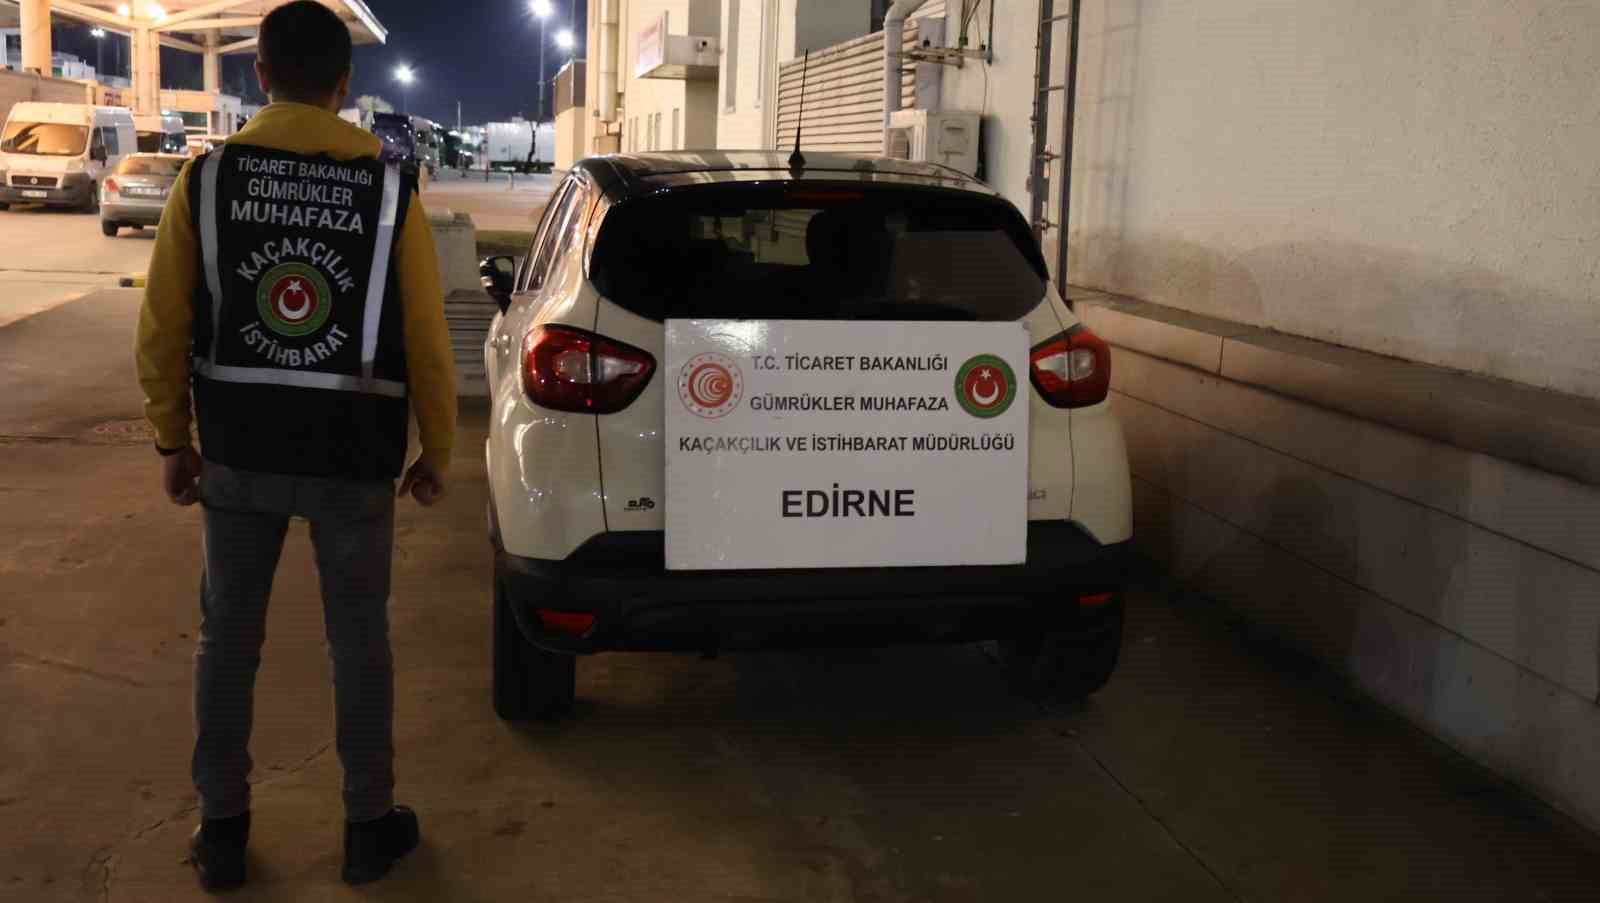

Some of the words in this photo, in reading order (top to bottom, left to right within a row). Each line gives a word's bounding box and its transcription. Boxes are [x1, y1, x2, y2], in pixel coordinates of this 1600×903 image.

[237, 155, 296, 176] TİCARET
[298, 162, 373, 187] BAKANLIĞI
[247, 175, 353, 207] GÜMRÜKLER
[231, 199, 364, 234] MUHAFAZA
[236, 237, 354, 293] KAÇAKÇILIK
[240, 321, 349, 366] İSTİHBARAT
[752, 355, 780, 371] T.C.
[785, 352, 855, 371] TİCARET
[859, 353, 948, 371] BAKANLIĞI
[750, 393, 856, 412] GÜMRÜKLER
[859, 396, 949, 411] MUHAFAZA
[679, 437, 781, 455] KAÇAKÇILIK
[786, 437, 808, 451] VE
[812, 433, 907, 451] İSTİHBARAT
[911, 433, 1015, 451] MÜDÜRLÜĞÜ
[781, 482, 915, 518] EDİRNE
